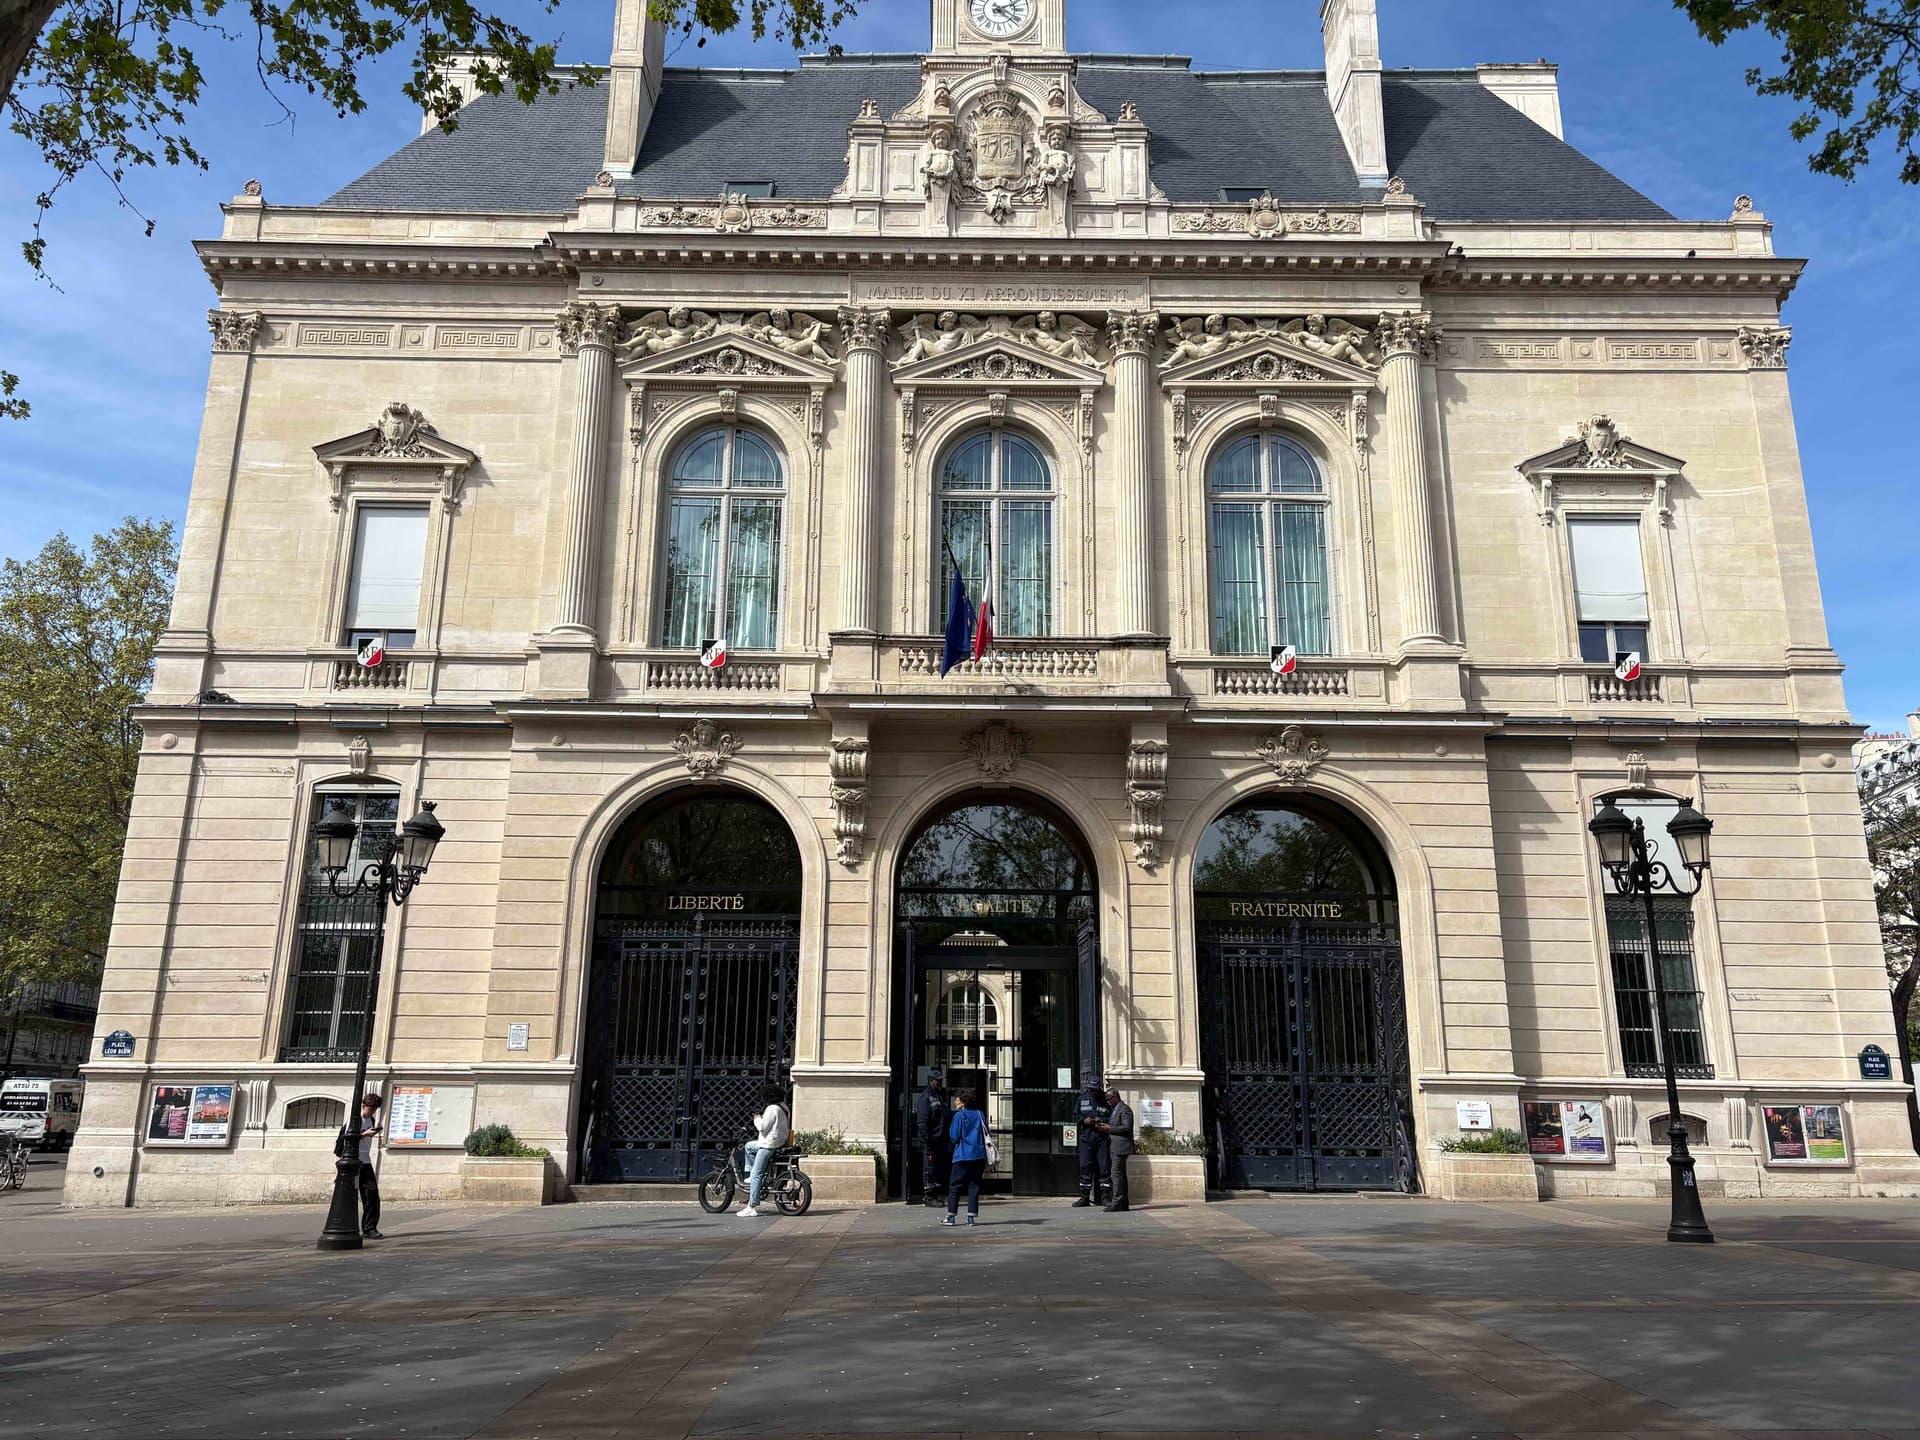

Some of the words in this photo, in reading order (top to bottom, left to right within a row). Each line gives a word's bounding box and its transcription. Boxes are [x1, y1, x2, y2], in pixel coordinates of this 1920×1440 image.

[867, 286, 924, 300] MAIRIE
[930, 286, 952, 300] DU
[958, 287, 976, 301] XI
[983, 287, 1129, 302] ARRONDISSEMENT
[668, 893, 745, 910] LIBERTÉ
[1230, 901, 1342, 918] FRATERNITÉ
